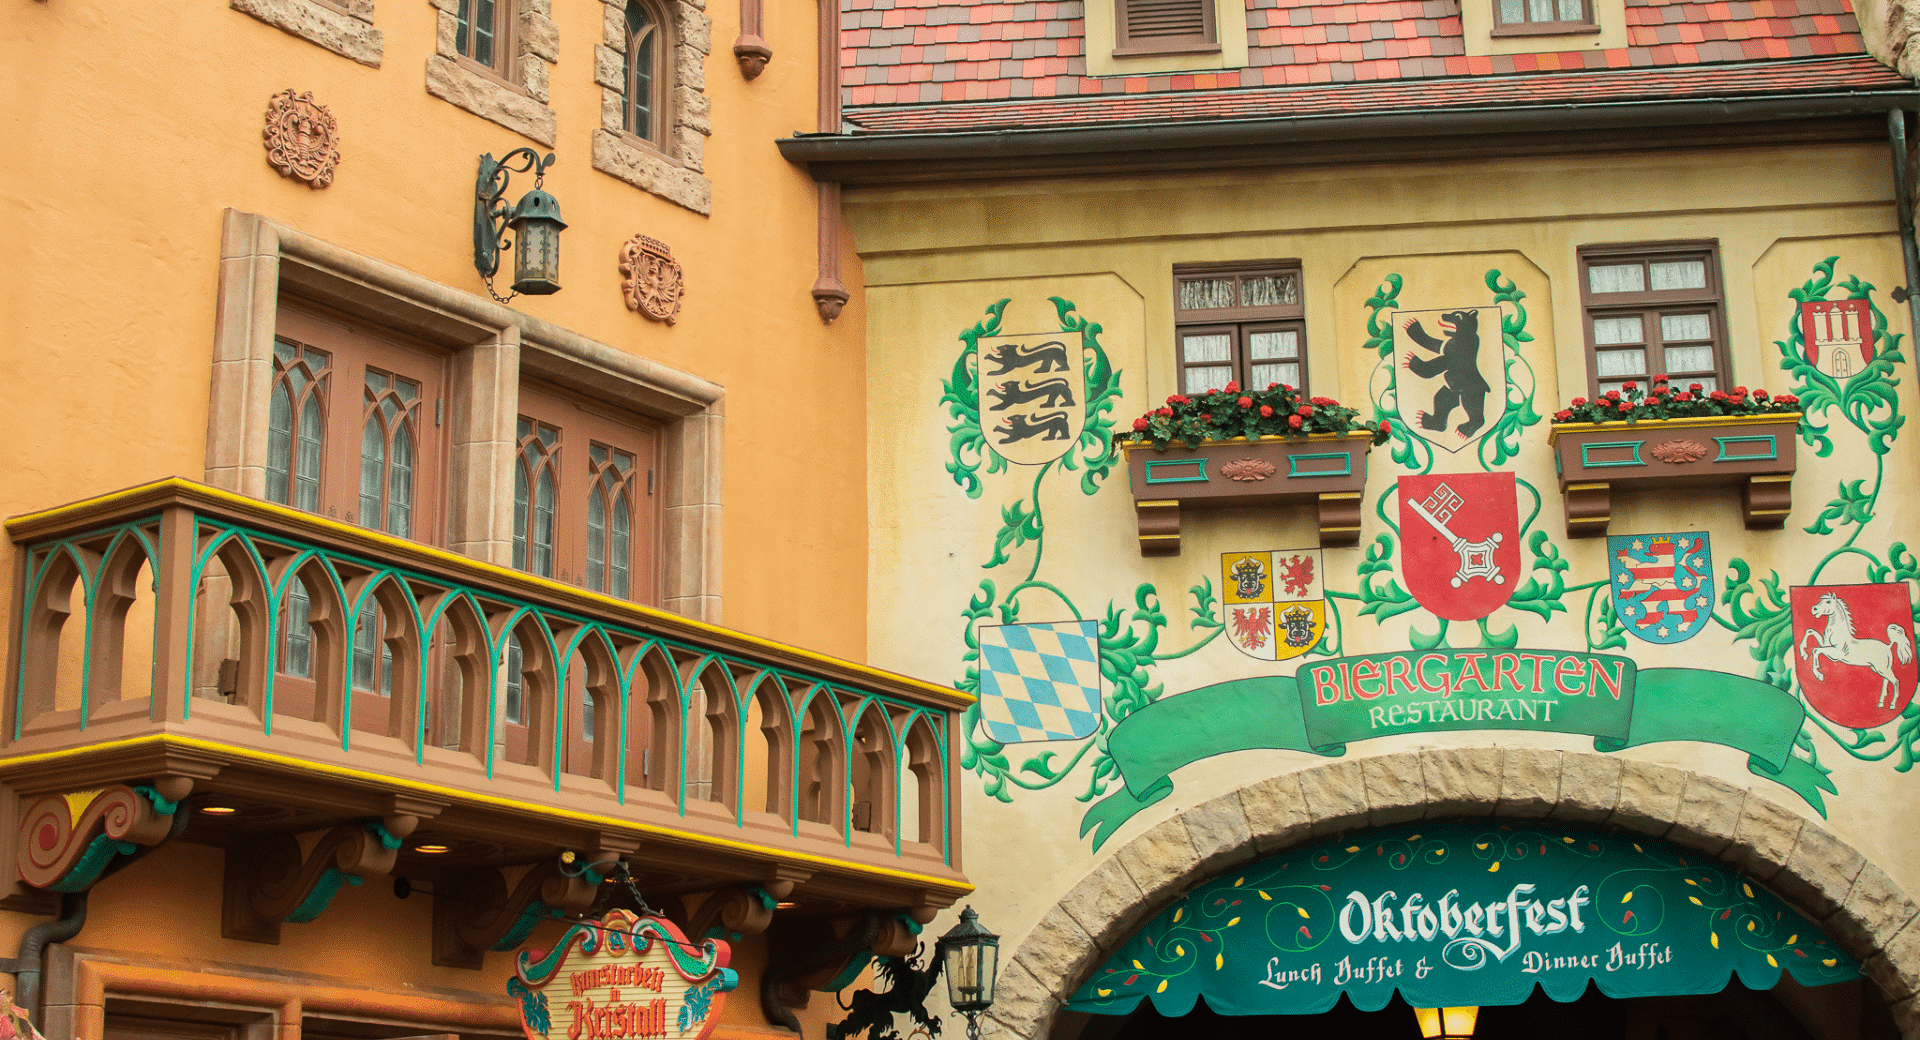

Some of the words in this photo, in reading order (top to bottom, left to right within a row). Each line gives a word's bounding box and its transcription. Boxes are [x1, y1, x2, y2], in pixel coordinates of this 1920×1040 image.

[1338, 883, 1591, 971] Oktoberfest
[1258, 956, 1322, 990] Lunch
[1333, 955, 1405, 985] Buffet
[1415, 956, 1434, 979] &
[1521, 951, 1600, 974] Dinner
[1605, 941, 1674, 972] Buffet
[609, 986, 621, 1002] in
[565, 996, 668, 1040] Kristall
